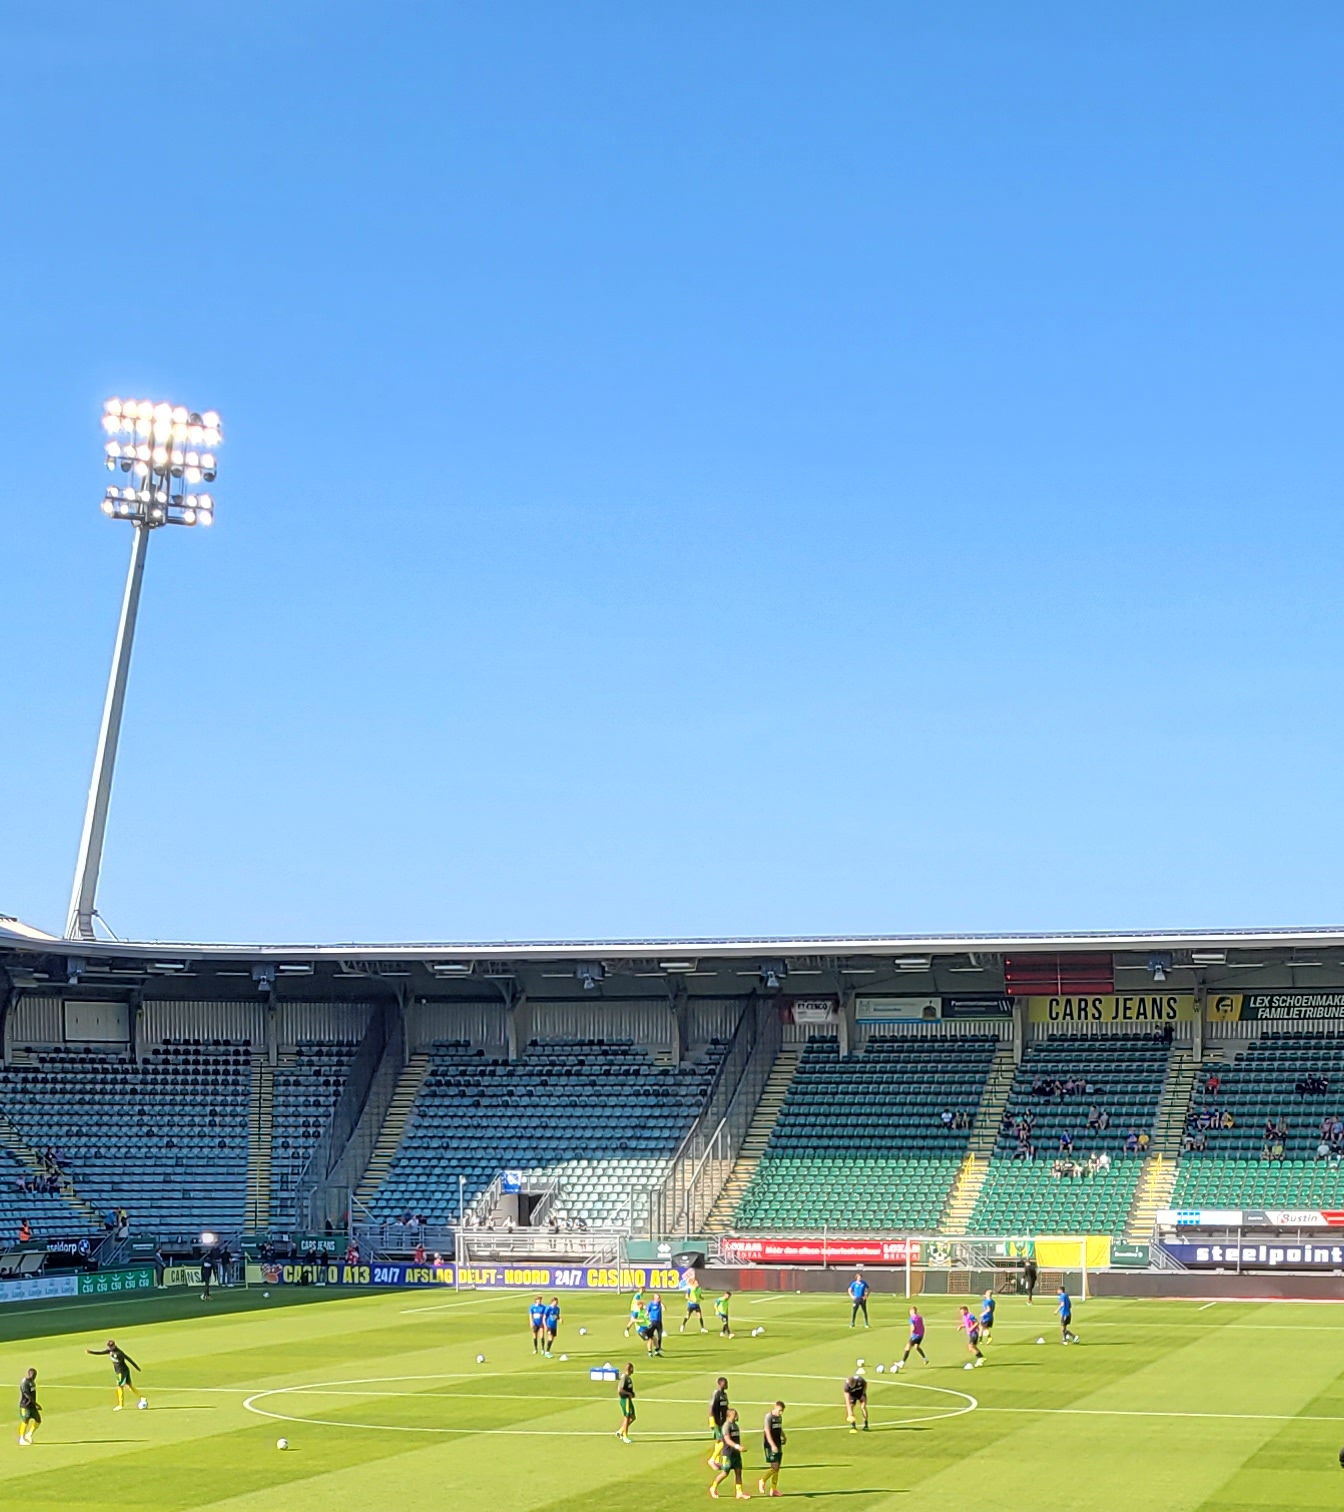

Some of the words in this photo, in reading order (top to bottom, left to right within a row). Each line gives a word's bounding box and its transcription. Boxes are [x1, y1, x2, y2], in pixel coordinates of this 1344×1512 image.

[1048, 997, 1103, 1021] CARS
[1112, 996, 1178, 1021] JEANS
[1250, 995, 1270, 1008] LEX
[46, 1240, 77, 1255] sseldorp
[1196, 1244, 1343, 1265] steelpoint
[342, 1265, 370, 1283] A13
[374, 1267, 400, 1282] 24/7
[406, 1267, 453, 1284] AFSLAG
[555, 1270, 582, 1286] 24/7
[587, 1269, 646, 1288] CASINO
[649, 1269, 680, 1288] A13
